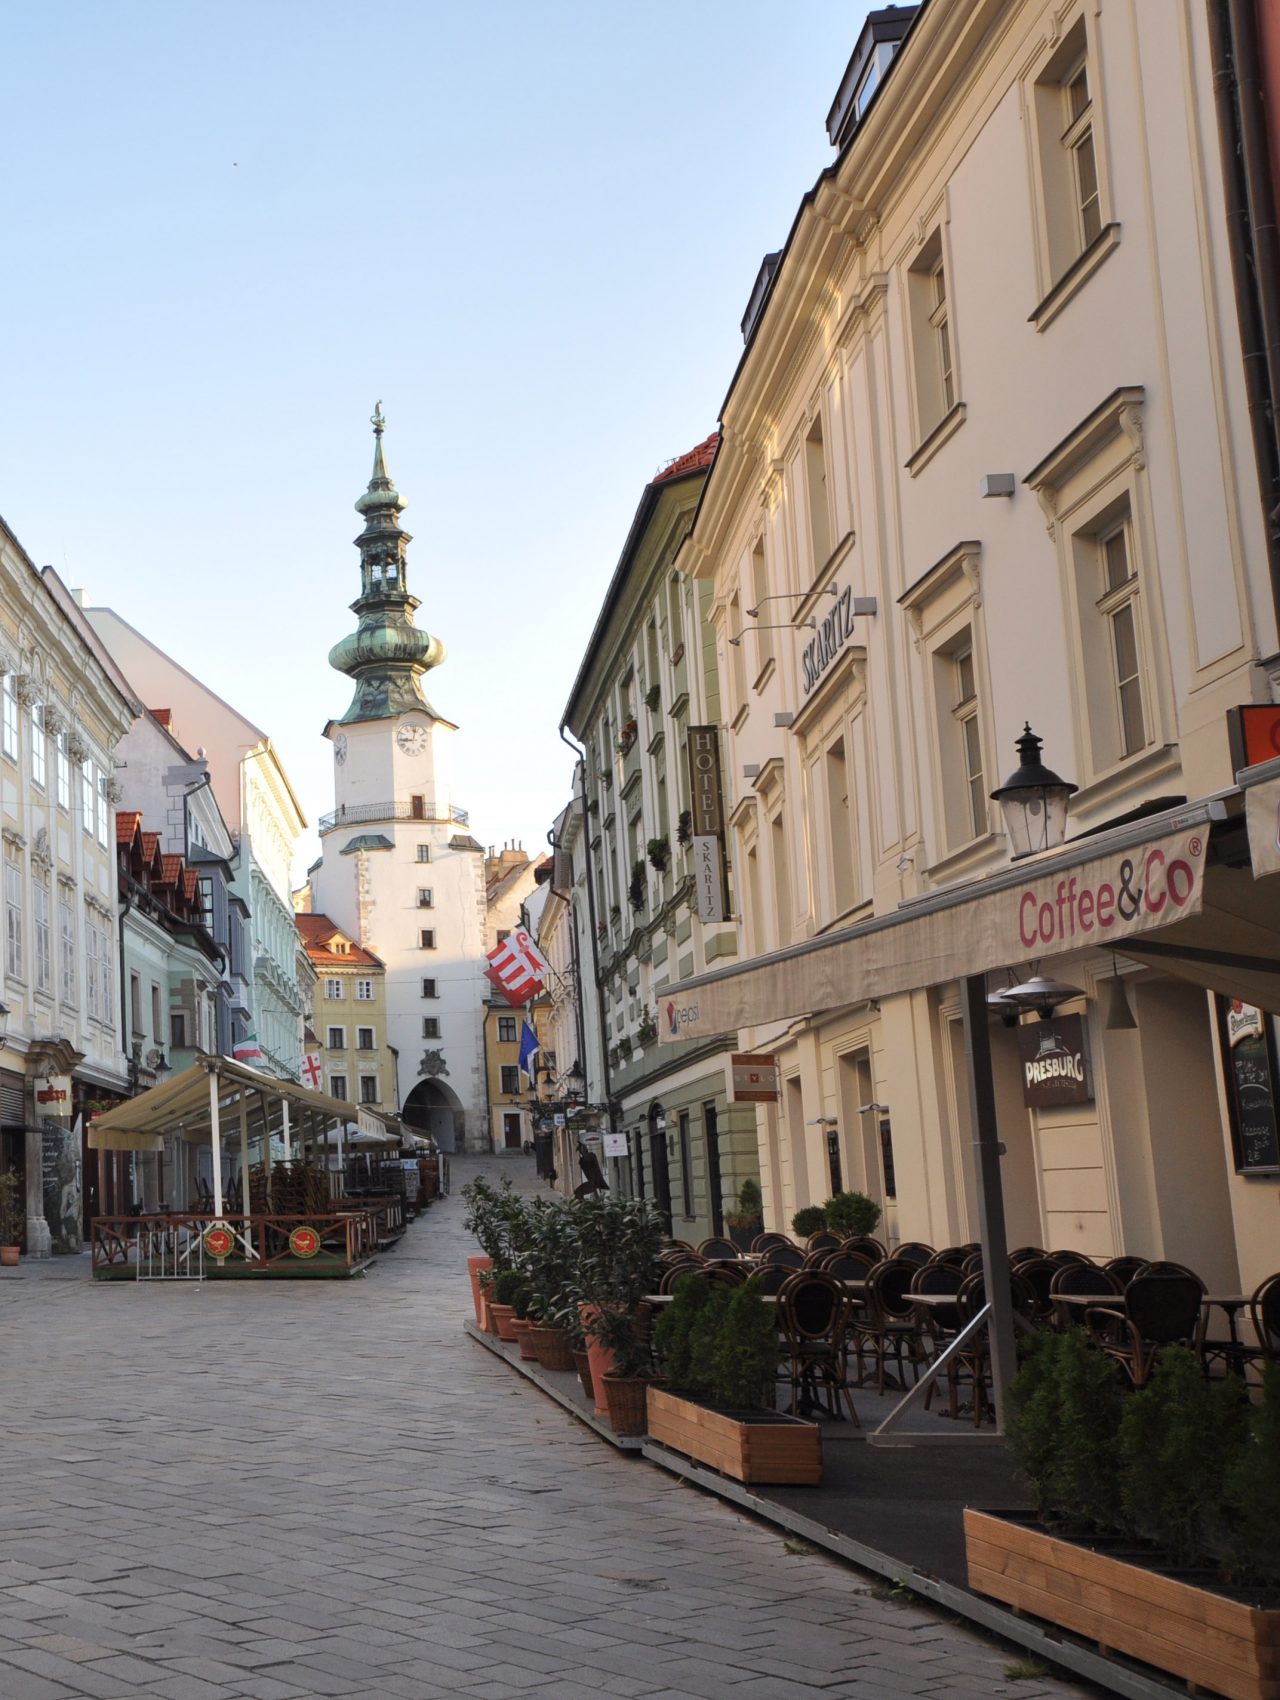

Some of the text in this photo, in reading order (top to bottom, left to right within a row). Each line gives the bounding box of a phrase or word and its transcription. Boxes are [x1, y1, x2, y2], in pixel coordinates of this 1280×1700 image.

[802, 584, 854, 695] SKARITZ
[695, 733, 717, 832] HOTEL
[702, 841, 716, 917] SKARITZ
[676, 1001, 699, 1028] pepsi
[1024, 1052, 1084, 1089] PRESBURG
